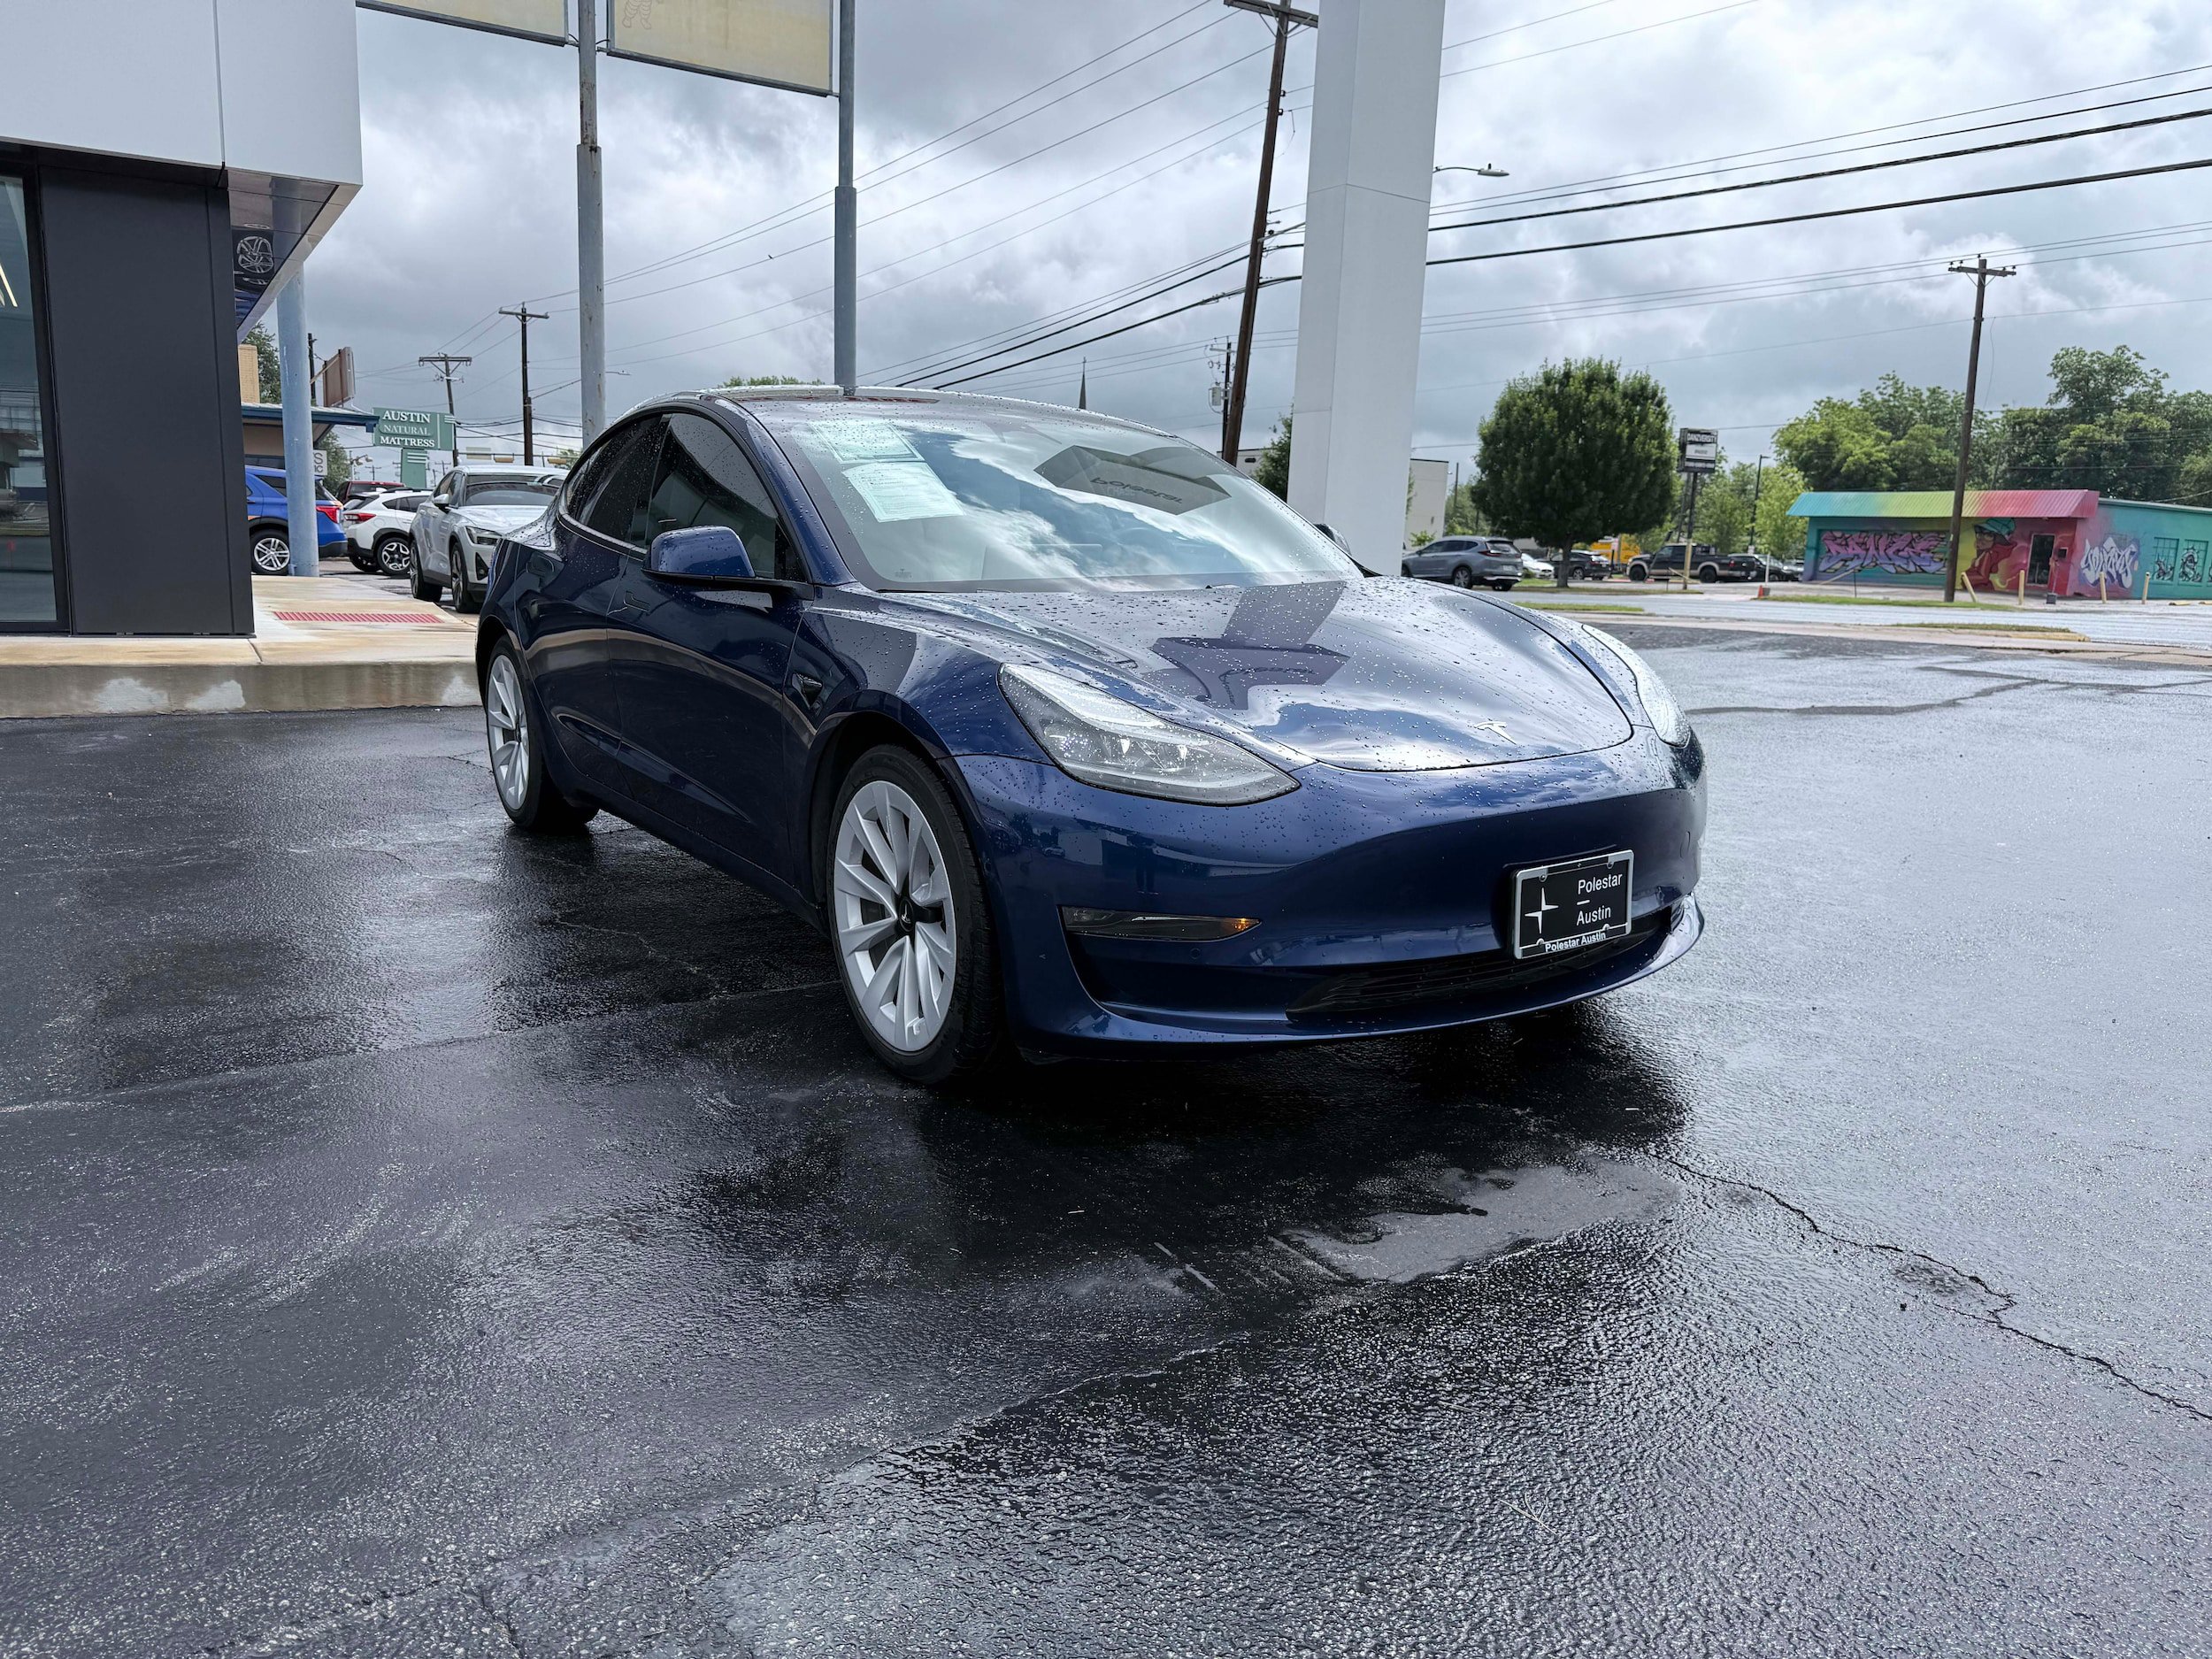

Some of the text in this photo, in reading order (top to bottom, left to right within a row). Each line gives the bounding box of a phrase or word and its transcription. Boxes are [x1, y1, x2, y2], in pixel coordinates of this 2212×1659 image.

[382, 411, 430, 423] AUSTIN
[383, 425, 431, 436] NATURAL
[380, 436, 434, 448] MATTRESS
[1578, 873, 1623, 895] Polestar
[1577, 905, 1611, 926] Austin
[1545, 932, 1607, 953] Polestar Austin
